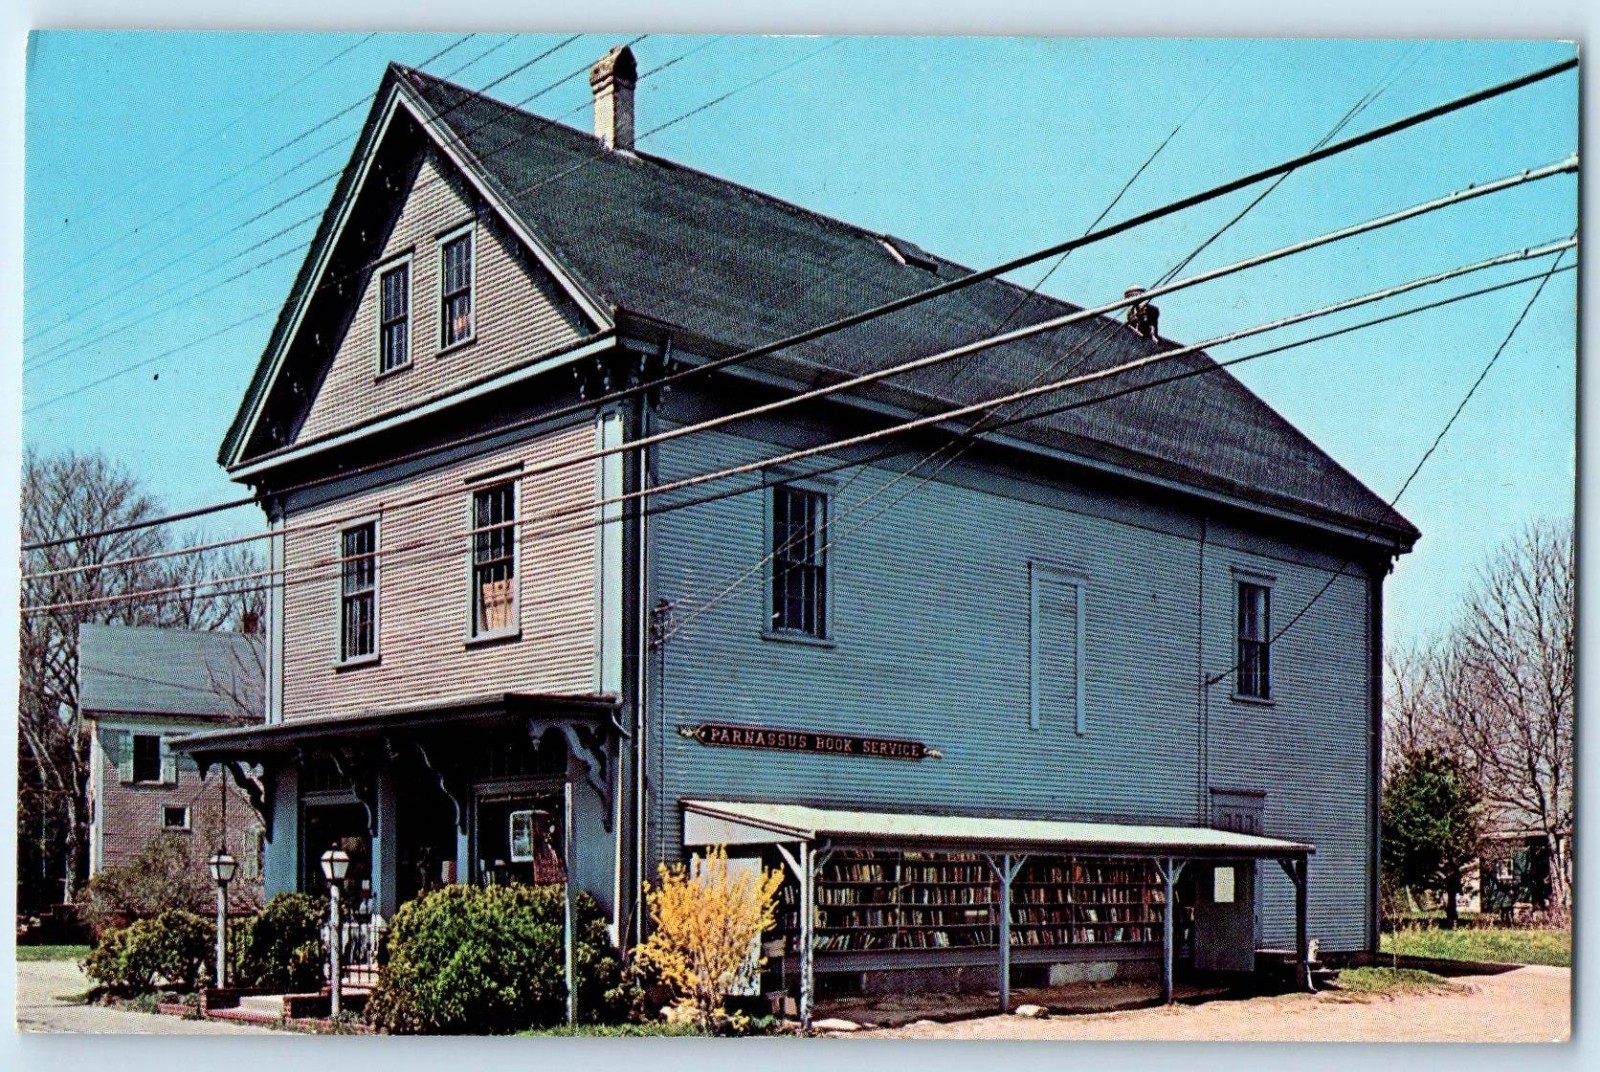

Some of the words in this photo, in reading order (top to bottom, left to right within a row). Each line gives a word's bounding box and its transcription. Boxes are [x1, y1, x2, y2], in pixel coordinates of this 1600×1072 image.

[710, 728, 807, 747] PARNASSUS
[815, 737, 853, 752] BOOK
[862, 740, 920, 757] SERVICE
